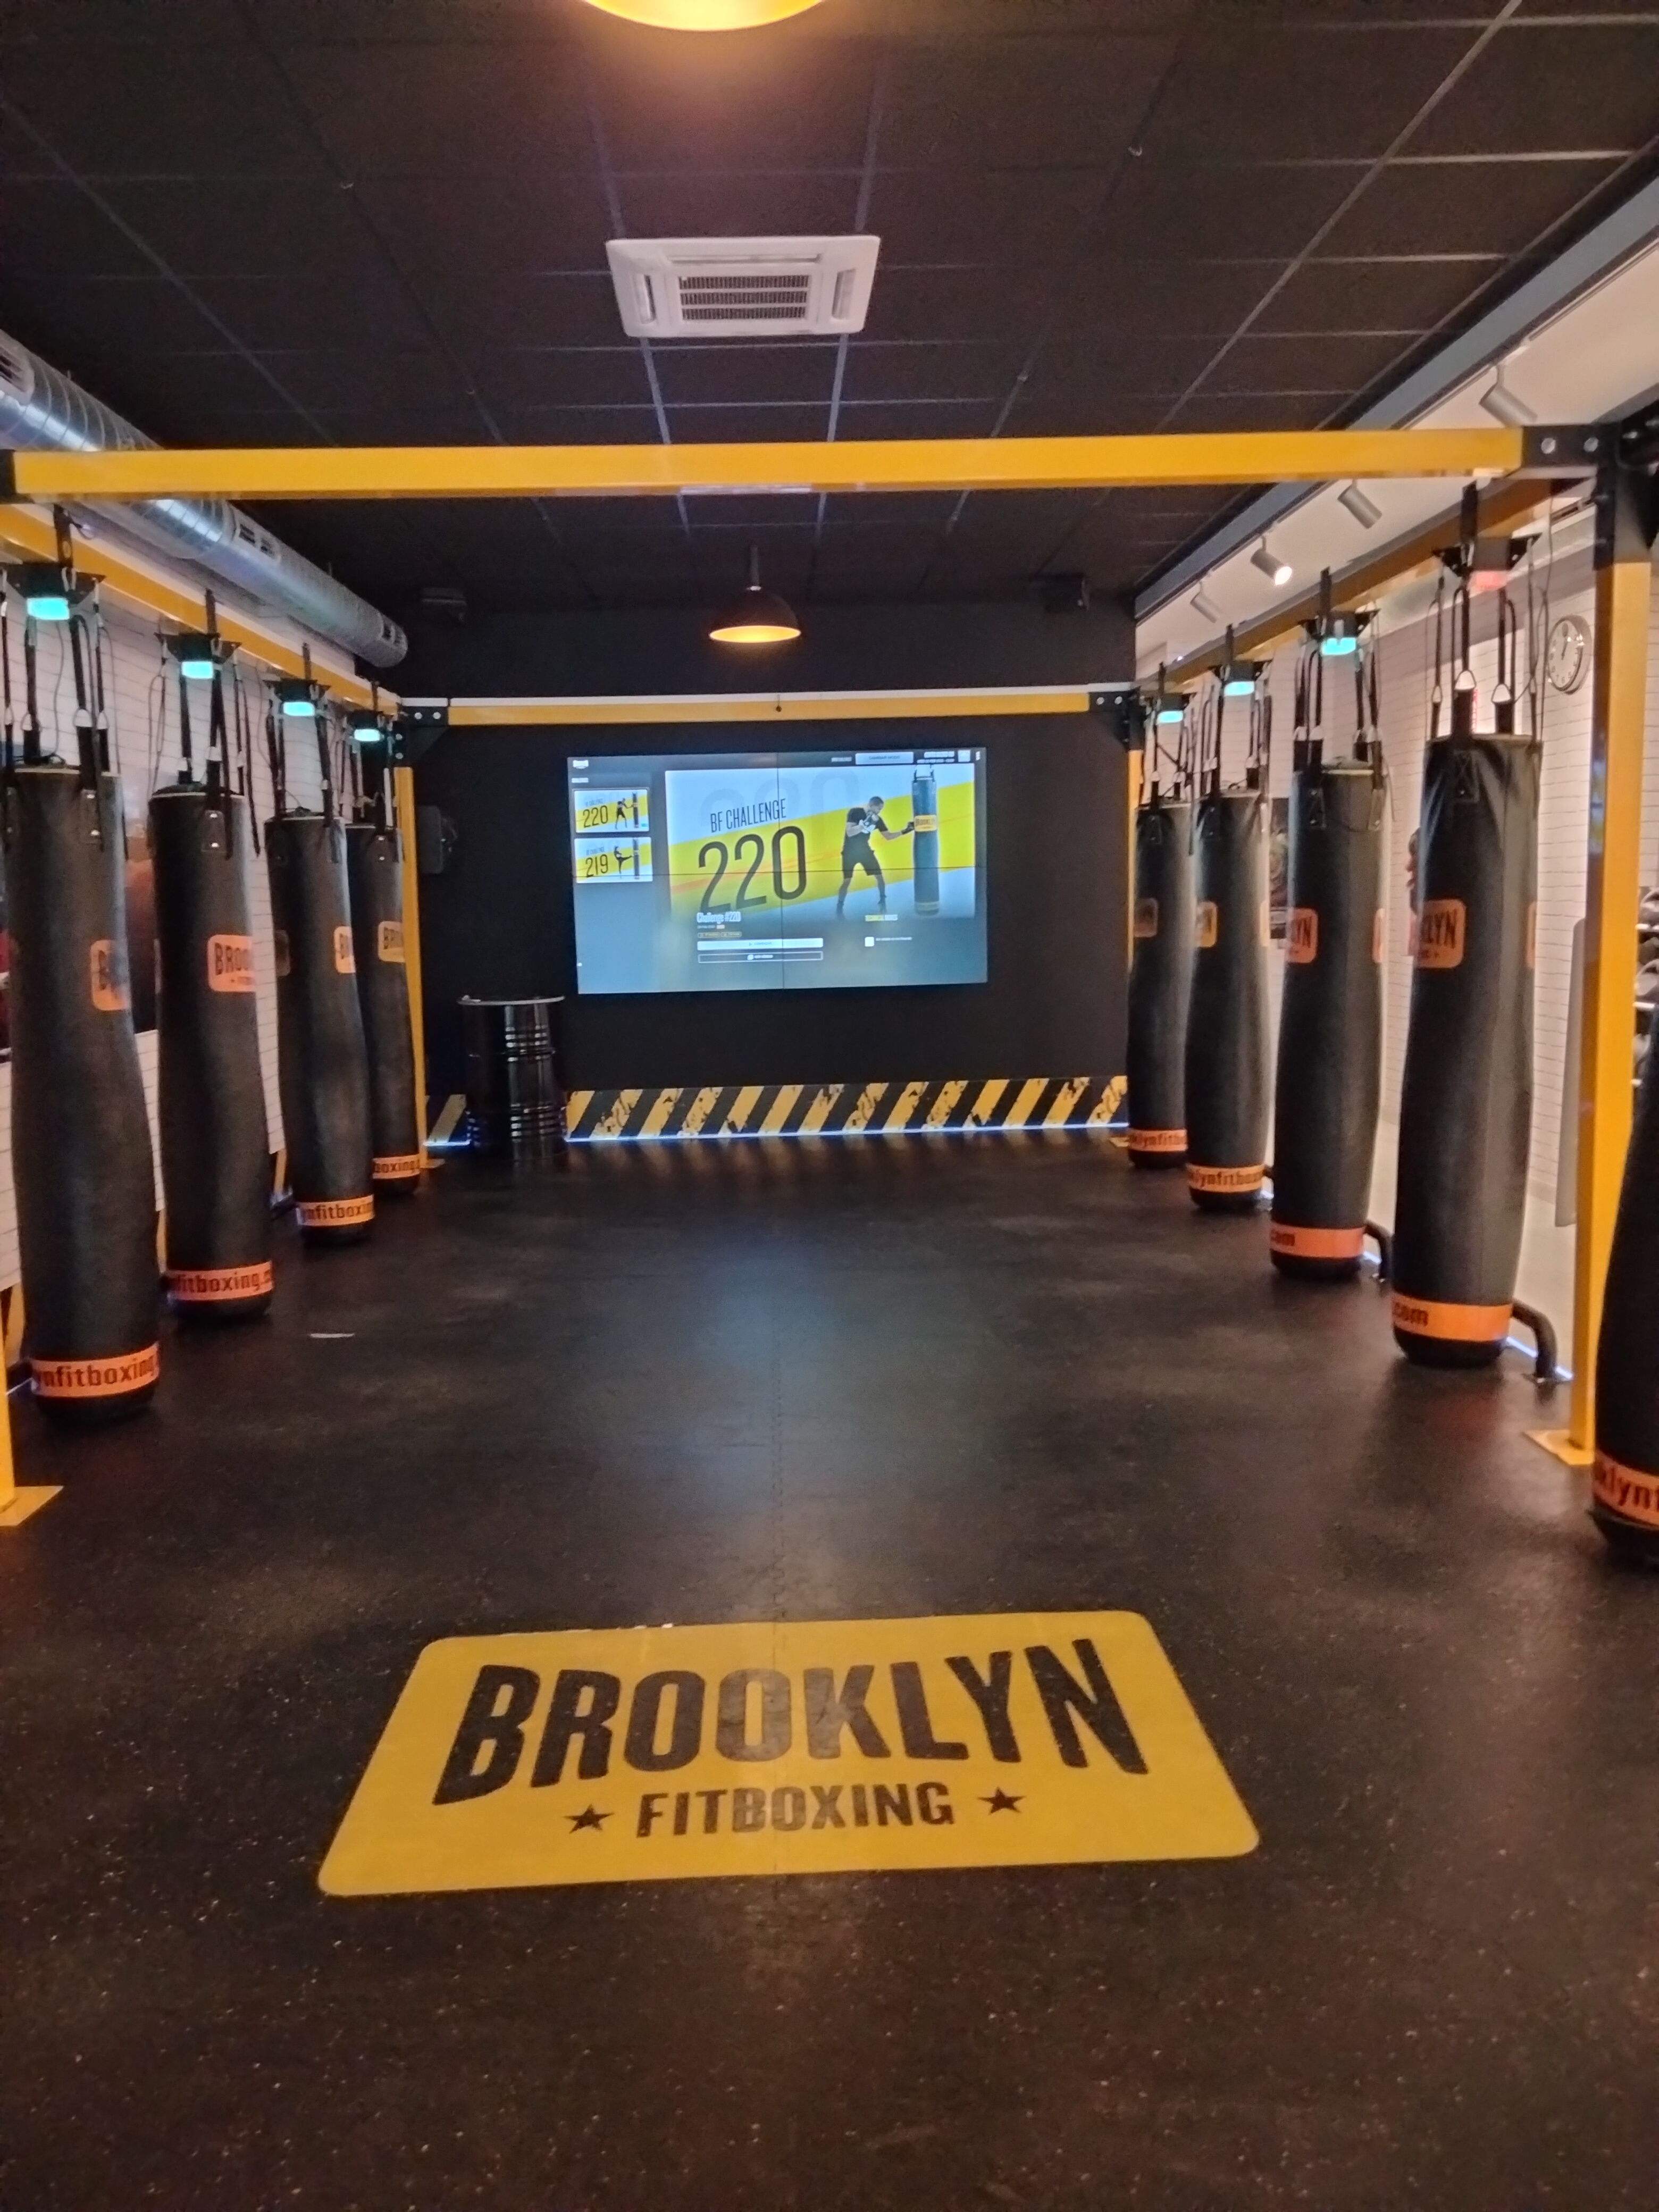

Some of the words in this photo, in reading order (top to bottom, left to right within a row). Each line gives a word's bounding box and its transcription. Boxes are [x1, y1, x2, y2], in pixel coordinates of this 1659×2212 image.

[582, 805, 609, 828] 220
[710, 811, 723, 833] BF
[726, 798, 787, 830] CHALLENGE
[585, 854, 609, 878] 219
[698, 826, 807, 913] 220
[697, 912, 724, 924] Challenge
[725, 911, 741, 922] #220
[433, 1639, 1150, 1805] BROOKLYN
[636, 1782, 956, 1838] FITBOXING
